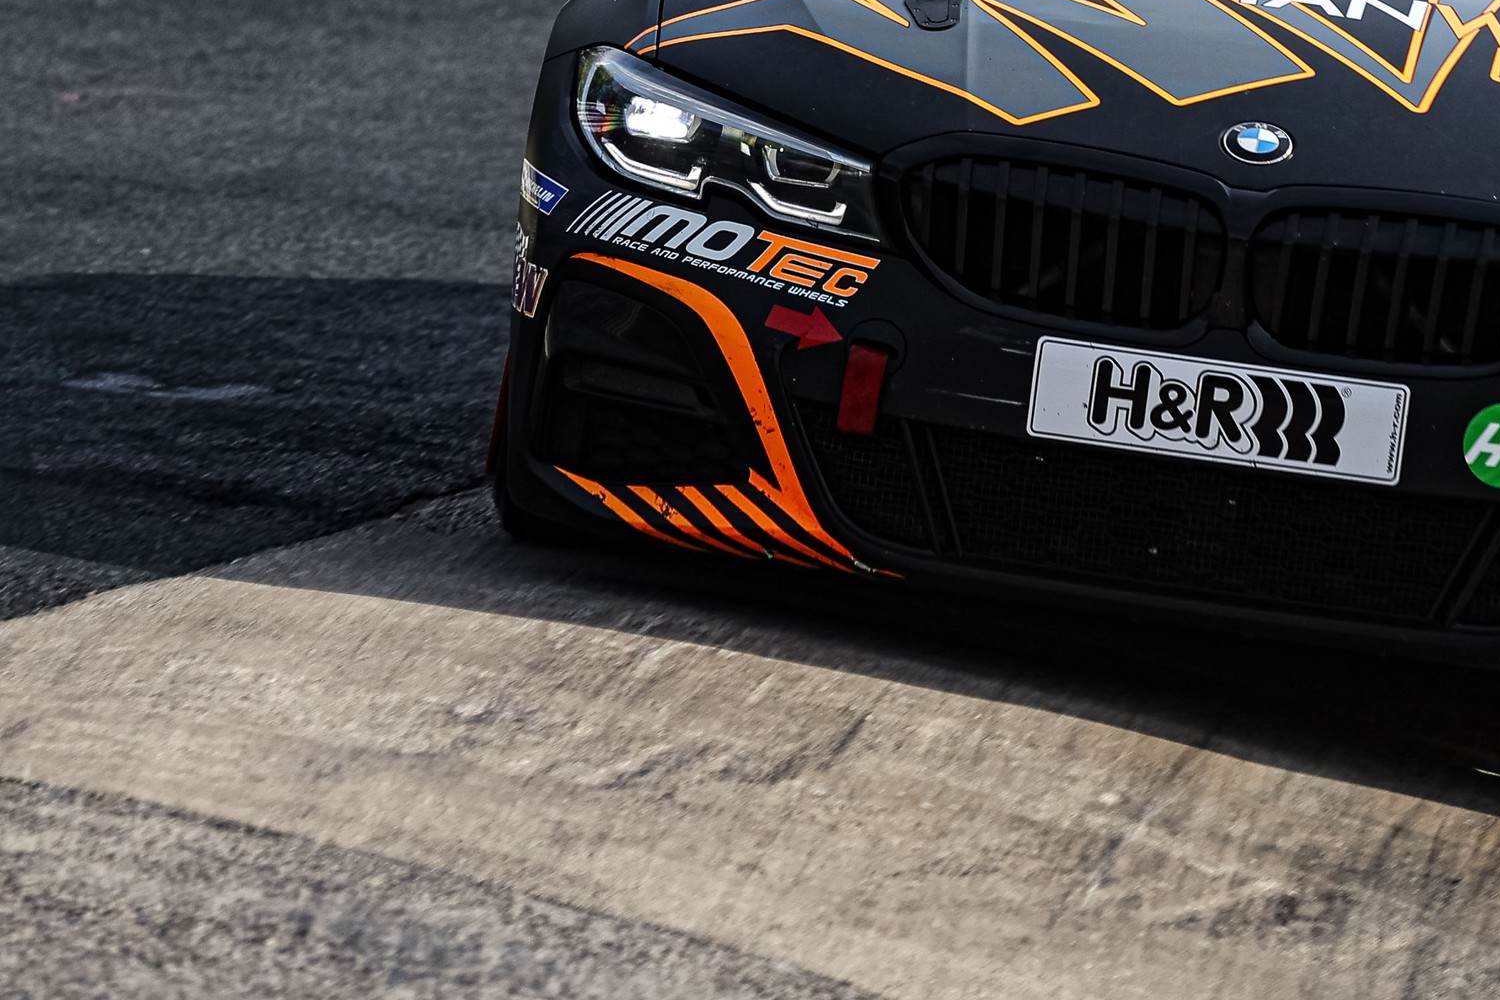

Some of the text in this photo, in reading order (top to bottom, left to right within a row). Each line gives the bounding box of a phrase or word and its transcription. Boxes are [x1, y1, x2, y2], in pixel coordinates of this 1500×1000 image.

[612, 236, 849, 308] RACE AND PERFORMANCE WHEELS
[1089, 356, 1253, 454] H&R
